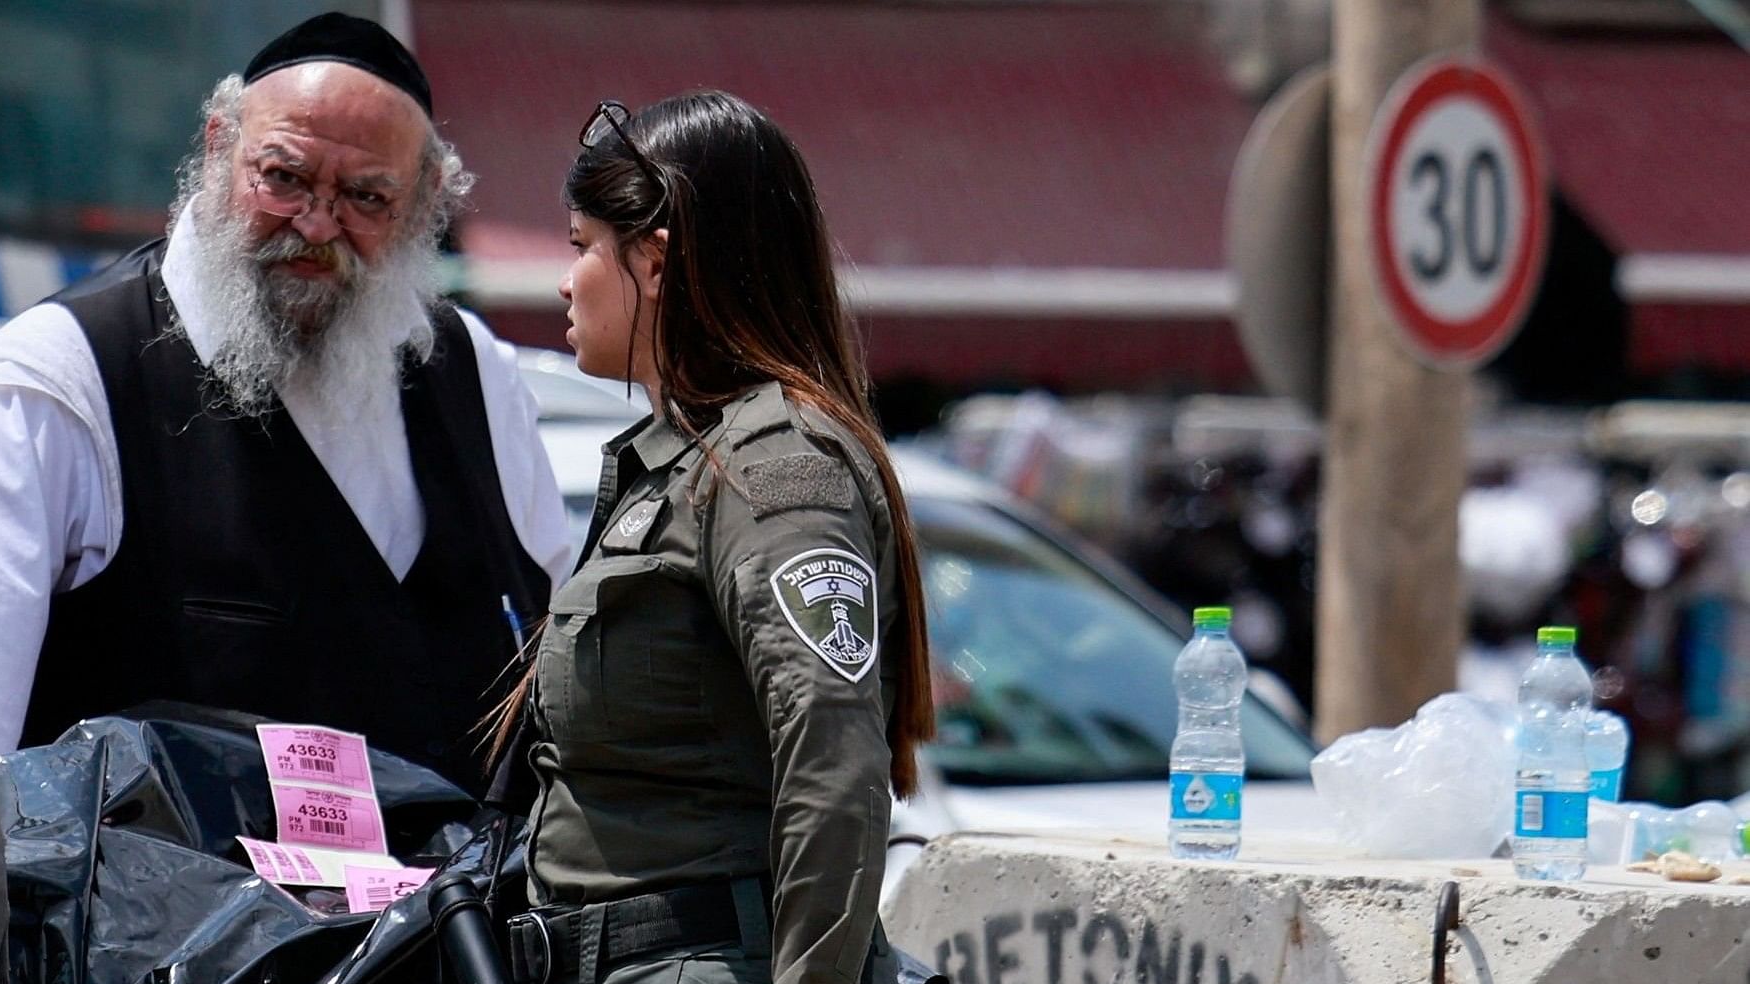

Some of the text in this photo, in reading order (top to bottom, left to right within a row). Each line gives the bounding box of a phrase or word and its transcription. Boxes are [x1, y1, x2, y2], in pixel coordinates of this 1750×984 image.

[1408, 149, 1508, 284] 30
[781, 560, 869, 587] משטרת ישראל
[286, 743, 337, 760] 43633
[297, 804, 348, 821] 43633
